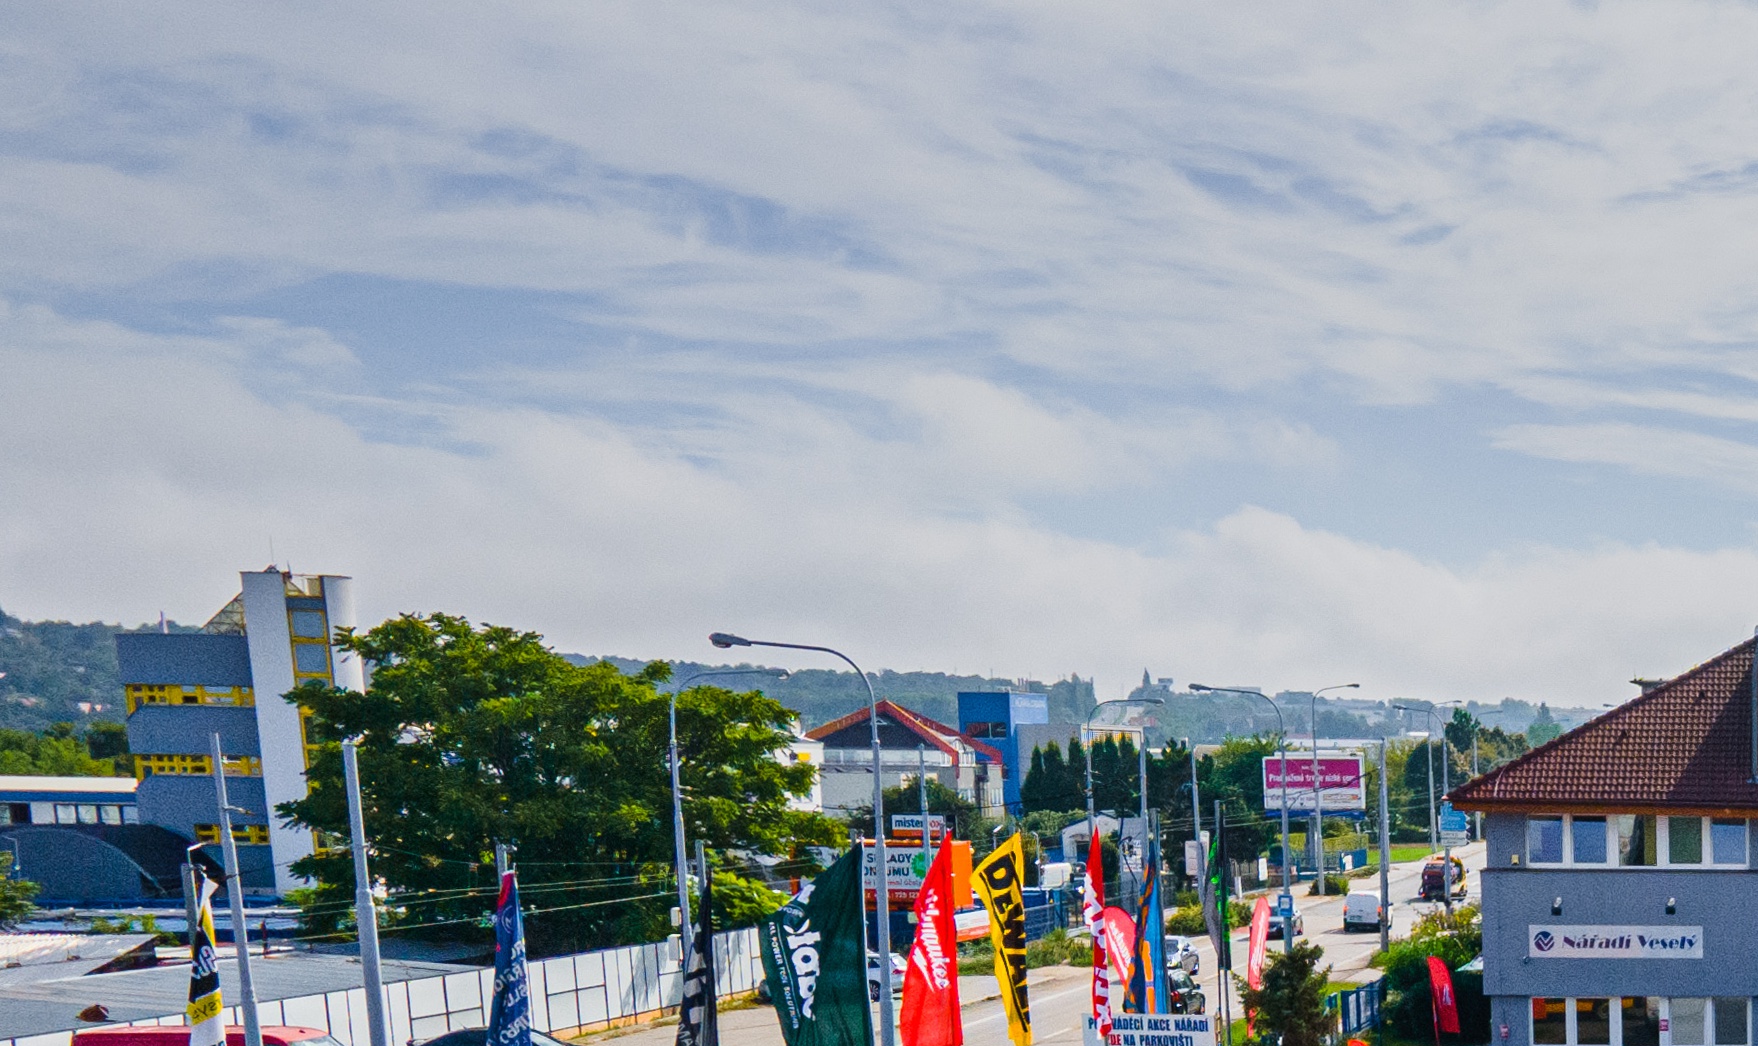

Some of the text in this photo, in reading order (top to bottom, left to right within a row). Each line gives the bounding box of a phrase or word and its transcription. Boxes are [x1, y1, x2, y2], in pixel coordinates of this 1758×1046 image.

[1562, 934, 1698, 949] Nářadí Veselý
[1147, 1018, 1171, 1032] AKCE
[1174, 1017, 1209, 1032] NÁŘADÍ
[1123, 1035, 1135, 1046] NA
